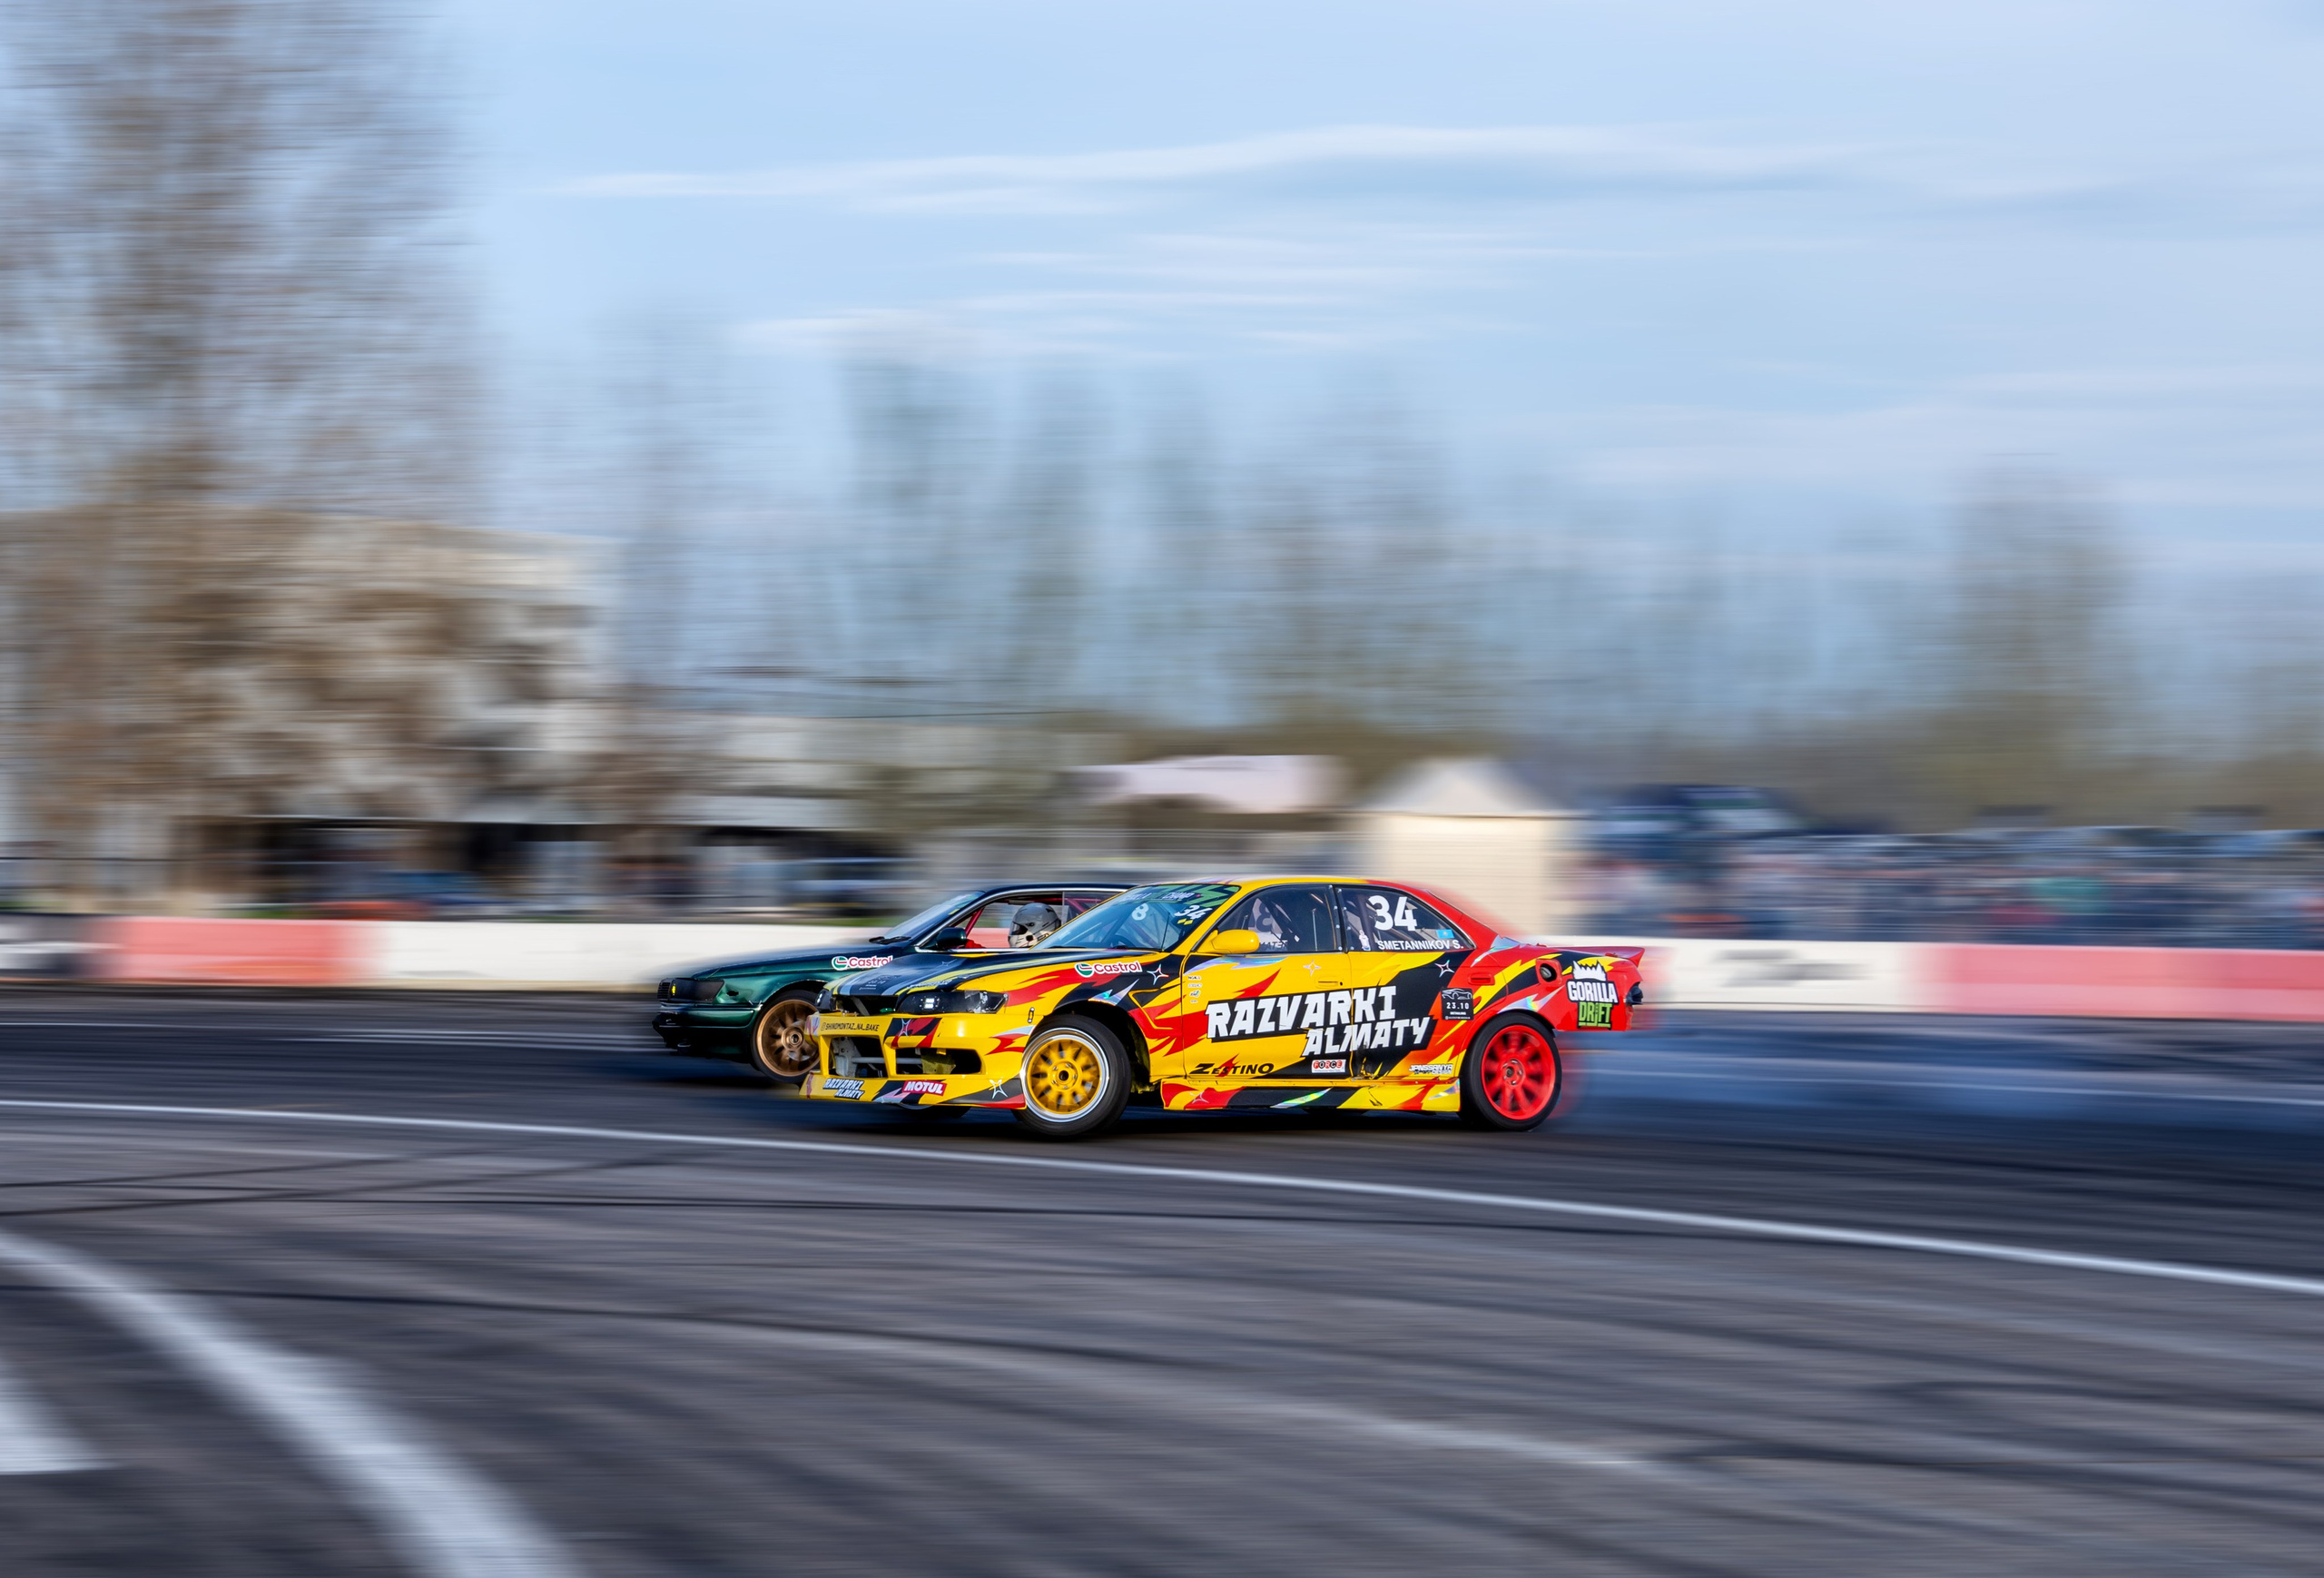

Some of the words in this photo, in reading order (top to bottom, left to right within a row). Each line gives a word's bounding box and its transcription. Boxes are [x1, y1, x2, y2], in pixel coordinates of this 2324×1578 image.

[1174, 904, 1213, 921] 34
[1368, 895, 1417, 931] 34
[1377, 940, 1450, 951] SMETANNIKOV
[1453, 940, 1463, 950] S.
[1094, 962, 1141, 973] Castrol
[1567, 981, 1619, 1003] GORILLA
[1205, 986, 1396, 1039] RAZVARKI
[1578, 1001, 1612, 1026] DRIFT
[1301, 1017, 1430, 1057] ALMATY
[1189, 1063, 1275, 1075] ZESTINO
[1314, 1060, 1343, 1069] FORCE
[823, 1078, 864, 1090] RAZVARKI
[904, 1081, 943, 1094] MOTUL
[834, 1089, 864, 1099] ALMATY
